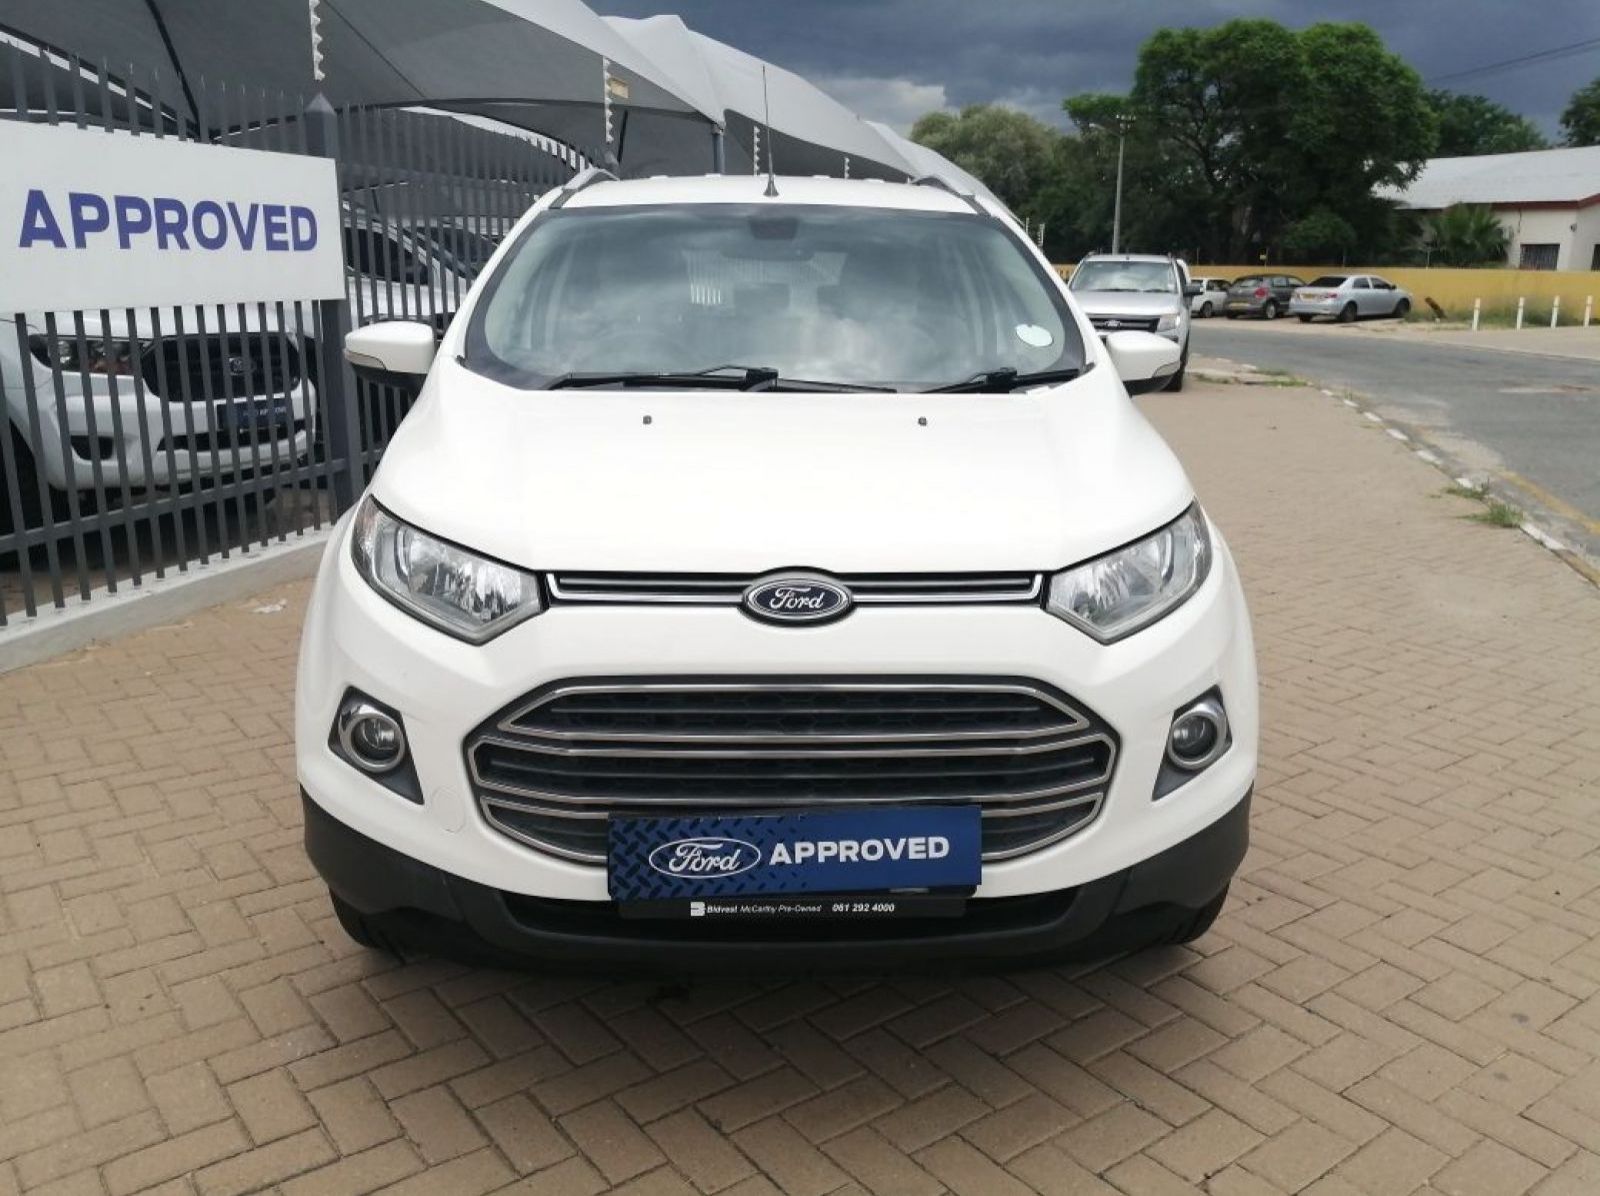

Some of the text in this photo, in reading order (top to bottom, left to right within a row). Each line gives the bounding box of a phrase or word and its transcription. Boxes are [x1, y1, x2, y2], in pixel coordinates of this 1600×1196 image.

[19, 189, 318, 251] APPROVED
[769, 586, 825, 609] Ford
[668, 836, 950, 872] Ford APPROVED
[707, 904, 738, 914] Bidvest
[852, 902, 870, 912] 292
